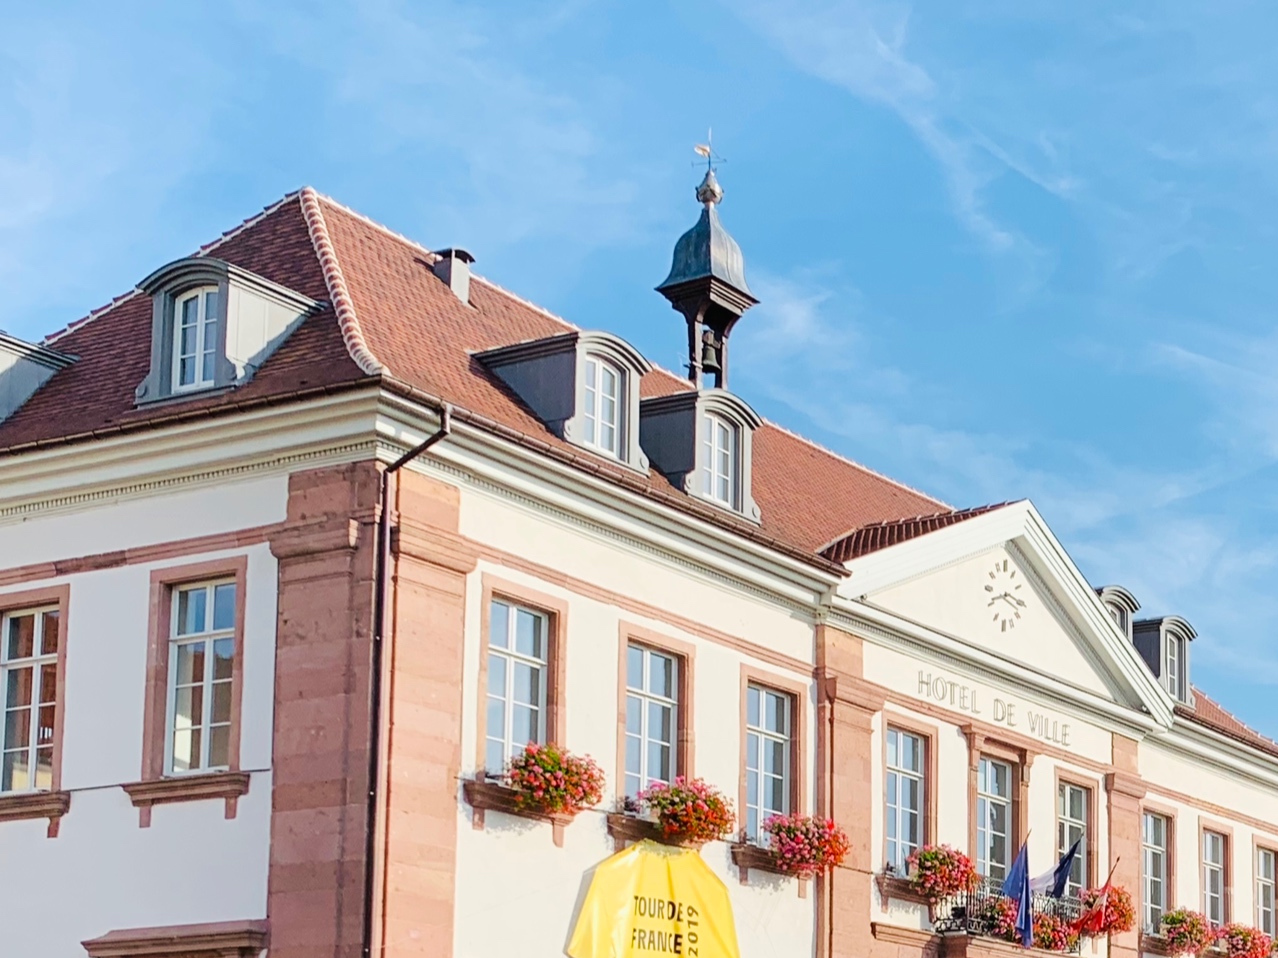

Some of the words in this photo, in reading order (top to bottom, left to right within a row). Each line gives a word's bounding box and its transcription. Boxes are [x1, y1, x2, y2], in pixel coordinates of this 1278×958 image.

[917, 669, 981, 714] HOTEL
[993, 698, 1017, 728] DE
[1027, 710, 1071, 747] VILLE
[634, 895, 665, 920] TOUR
[667, 900, 684, 923] DE
[631, 928, 683, 955] FRANCE
[687, 905, 699, 958] 2019
